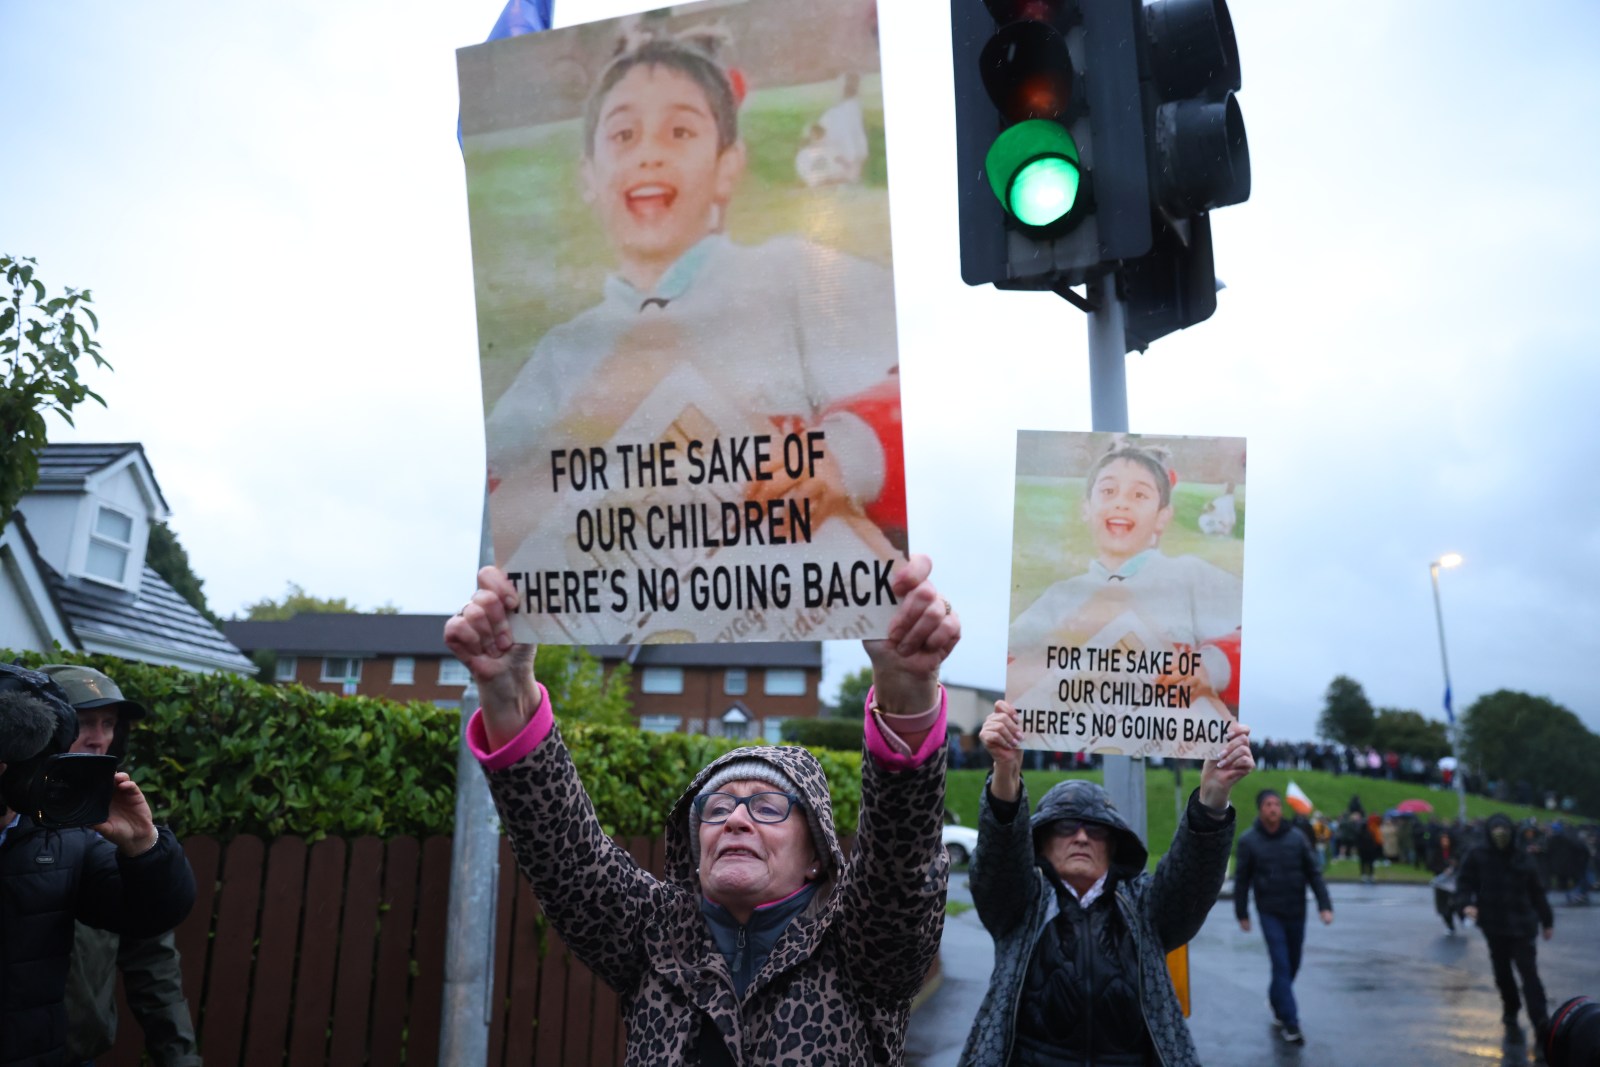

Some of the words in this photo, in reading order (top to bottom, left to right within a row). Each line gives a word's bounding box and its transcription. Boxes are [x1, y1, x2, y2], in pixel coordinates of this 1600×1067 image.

[551, 447, 609, 492] FOR
[617, 441, 677, 489] THE
[688, 435, 772, 484] SAKE
[784, 432, 824, 479] OF
[577, 507, 637, 552] OUR
[647, 498, 811, 549] CHILDREN
[639, 567, 680, 612] NO
[690, 563, 791, 611] GOING
[803, 559, 898, 608] BACK
[1047, 646, 1081, 670] FOR
[1087, 648, 1121, 672] THE
[1126, 650, 1172, 675] SAKE
[1179, 652, 1201, 676] OF
[1059, 679, 1094, 703] OUR
[1100, 682, 1190, 708] CHILDREN
[1092, 714, 1116, 738] NO
[1122, 716, 1176, 741] GOING
